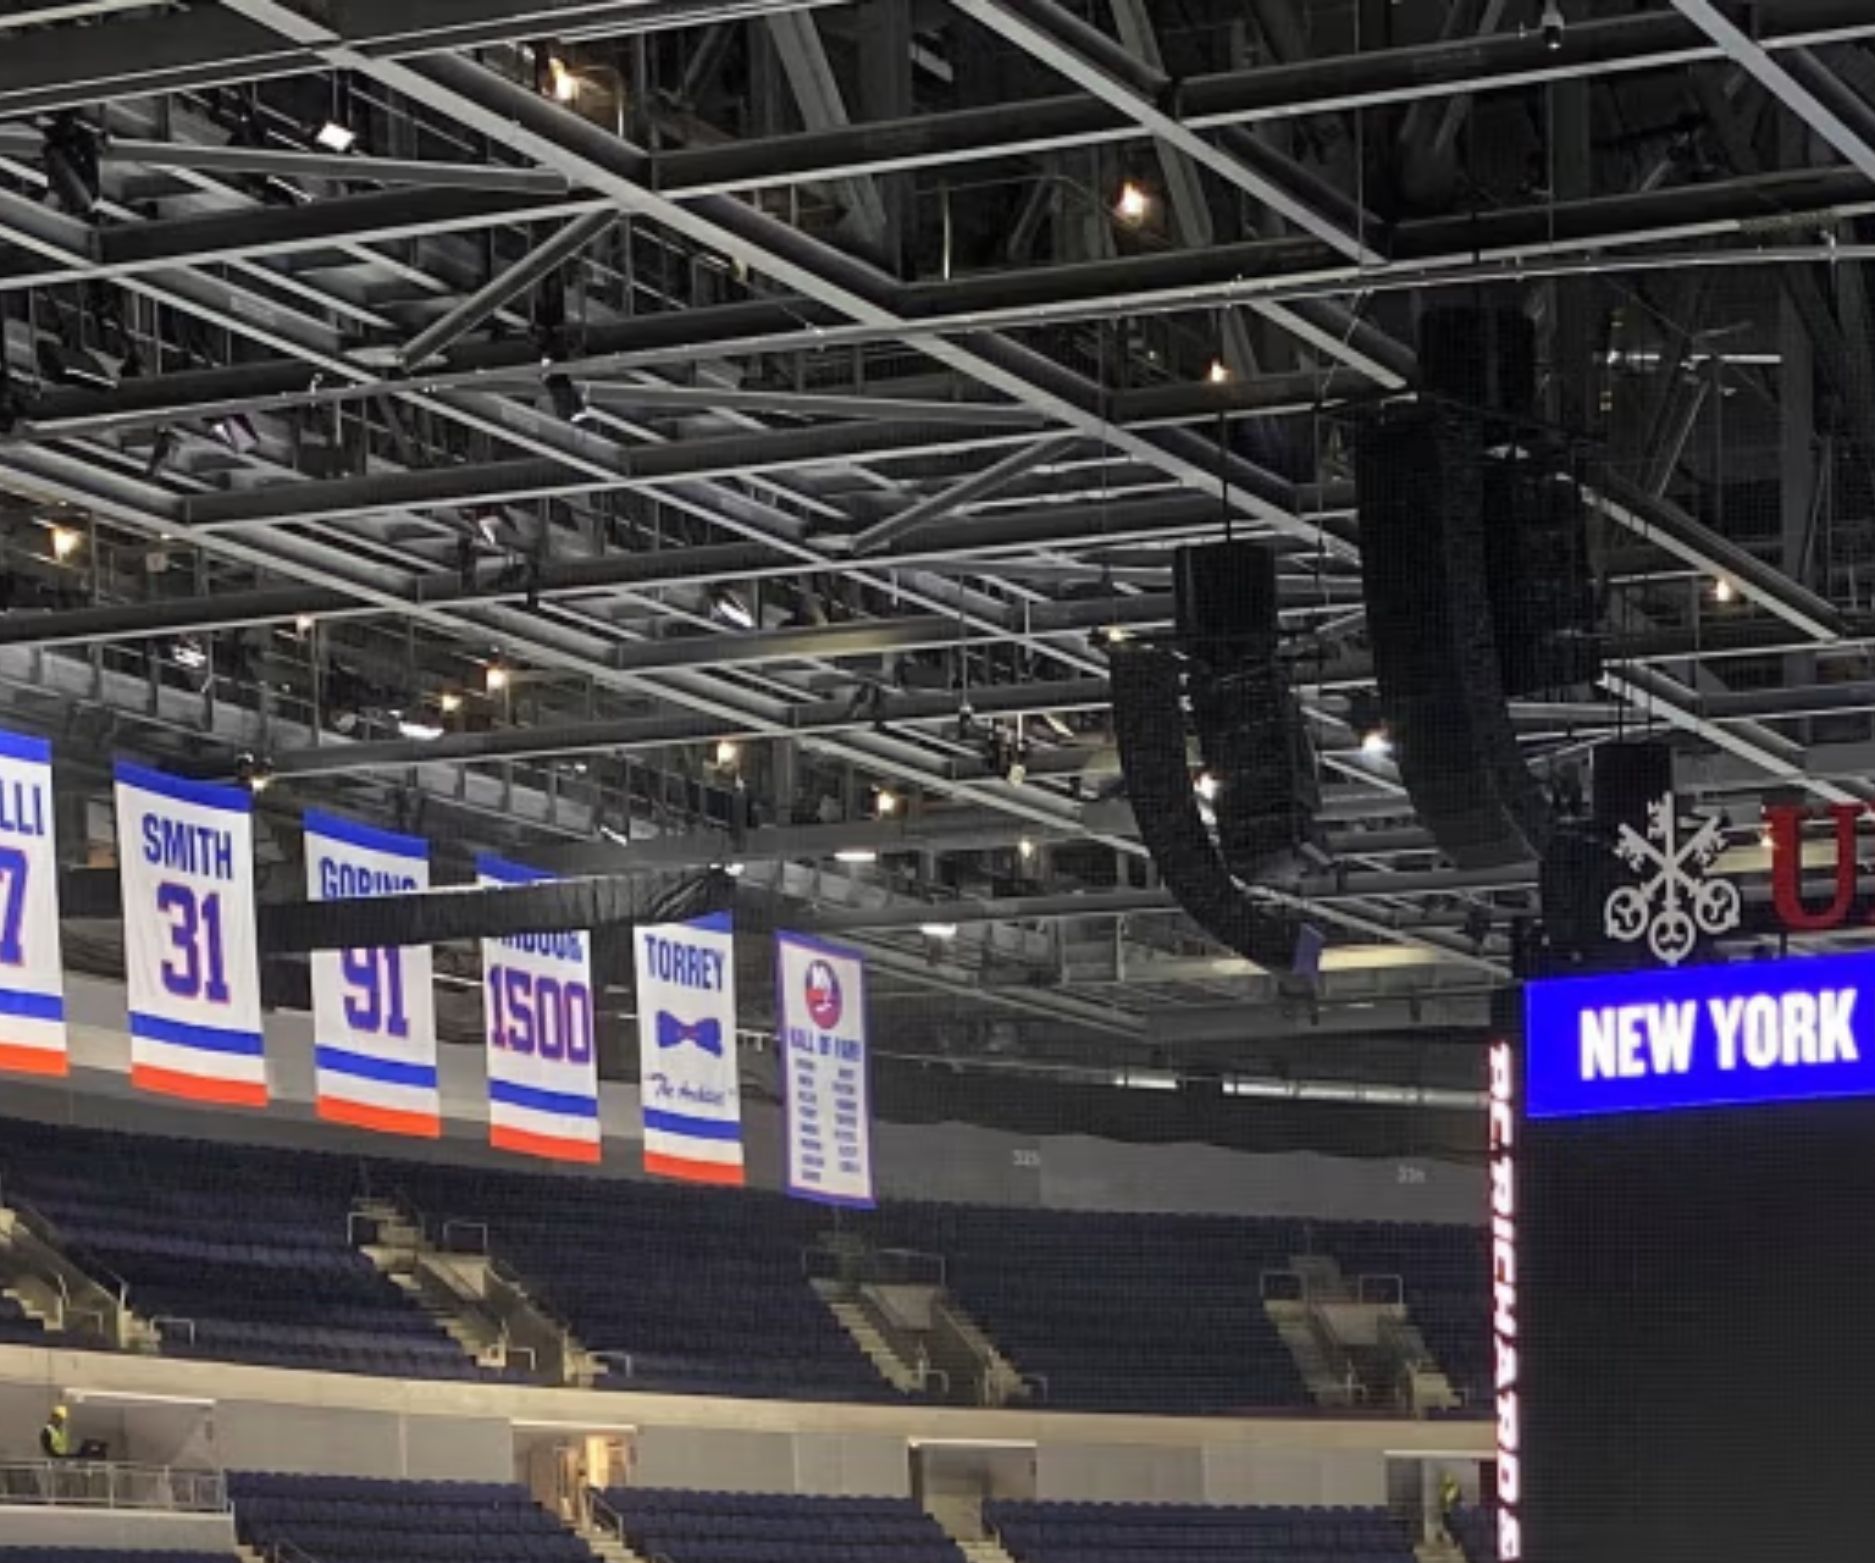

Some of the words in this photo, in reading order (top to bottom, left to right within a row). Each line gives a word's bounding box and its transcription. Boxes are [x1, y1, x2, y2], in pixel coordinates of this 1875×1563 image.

[141, 812, 232, 880] SMITH
[157, 879, 230, 1004] 31
[644, 934, 724, 992] TORREY
[341, 946, 409, 1039] 91
[488, 965, 592, 1064] 1500
[1580, 1000, 1697, 1081] NEW
[1708, 988, 1859, 1070] YORK
